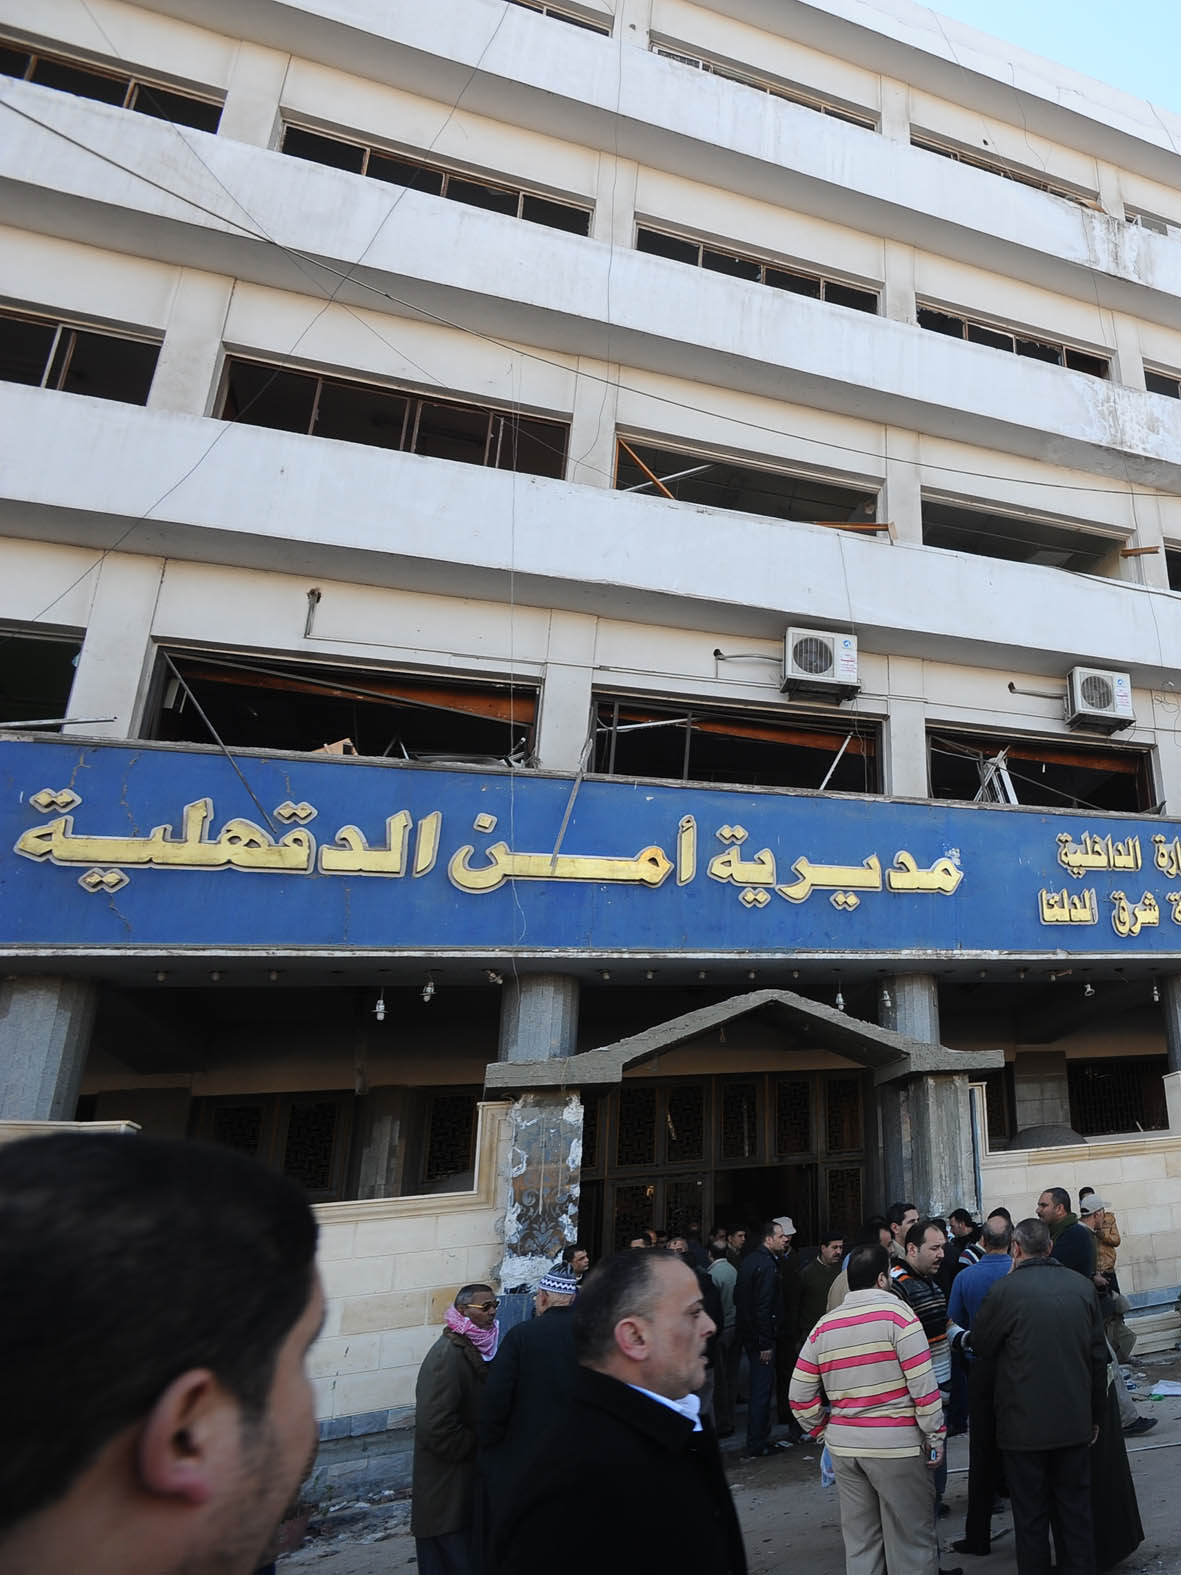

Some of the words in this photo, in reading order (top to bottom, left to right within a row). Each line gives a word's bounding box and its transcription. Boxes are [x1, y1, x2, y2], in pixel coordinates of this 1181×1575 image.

[14, 788, 441, 892] الدقهلية
[448, 813, 697, 895] أمن
[708, 825, 964, 911] مديرية
[1056, 831, 1142, 879] الداخلية
[1039, 887, 1099, 926] الدلتا
[1110, 890, 1160, 937] شرق
